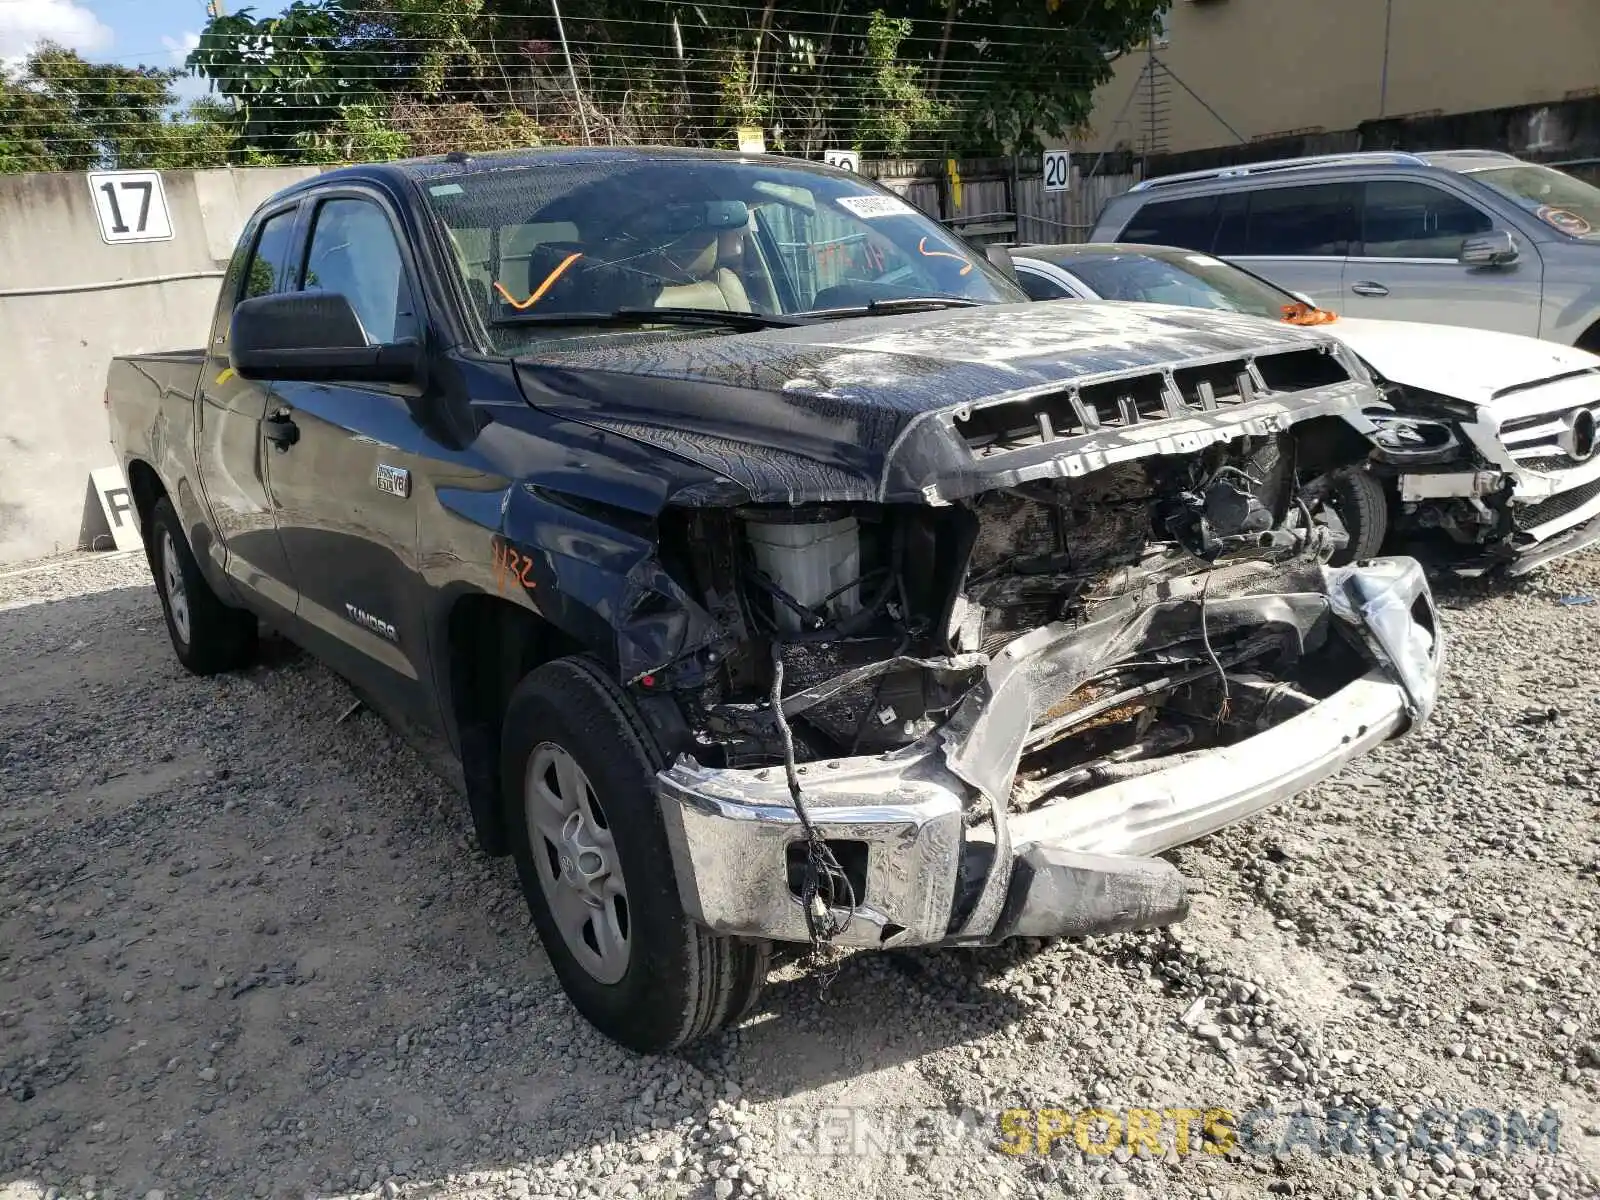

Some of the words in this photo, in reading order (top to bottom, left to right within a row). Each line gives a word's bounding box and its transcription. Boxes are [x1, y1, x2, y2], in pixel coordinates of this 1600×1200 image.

[1046, 155, 1067, 186] 20
[100, 181, 152, 233] 17
[345, 603, 398, 642] TUNDRA
